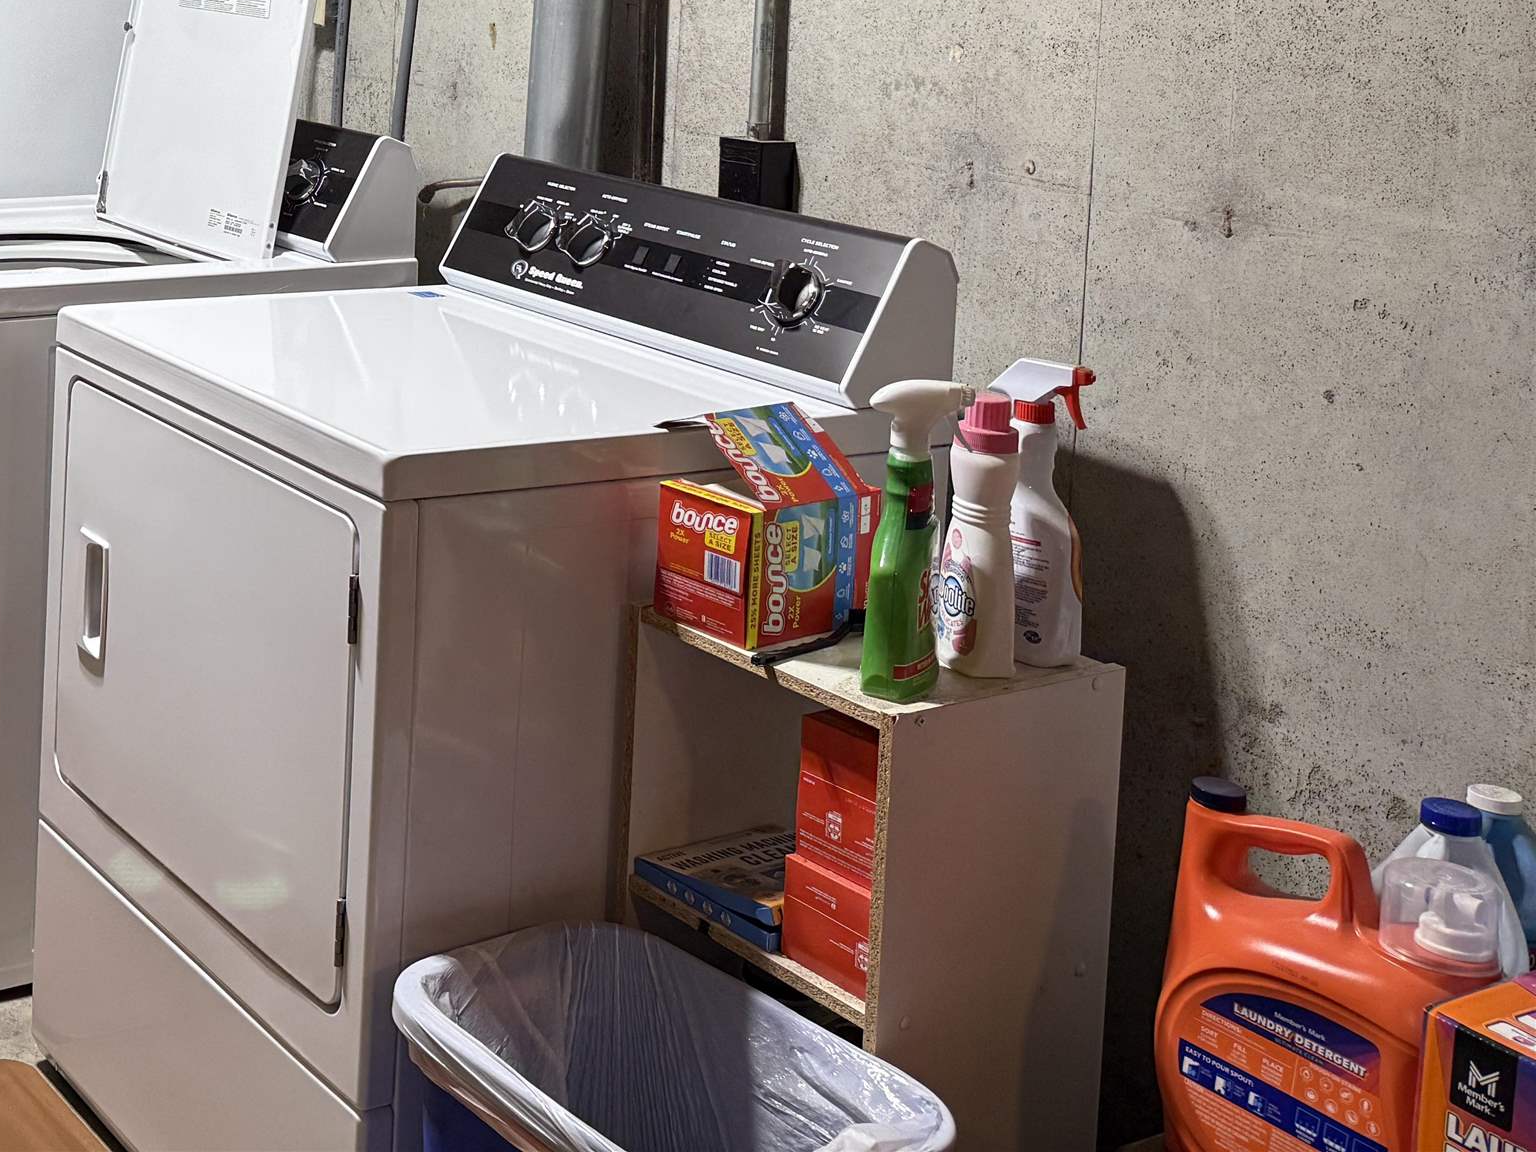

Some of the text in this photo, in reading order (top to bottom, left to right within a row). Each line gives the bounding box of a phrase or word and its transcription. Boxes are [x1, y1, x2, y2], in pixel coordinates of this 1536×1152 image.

[528, 265, 556, 281] Speed
[671, 500, 739, 534] bounce
[669, 531, 690, 545] Power
[675, 527, 685, 538] 2X
[708, 531, 733, 544] SELECT
[714, 540, 731, 552] SIZE
[791, 526, 799, 554] SIZE
[753, 532, 761, 572] SHEETS
[751, 573, 759, 606] MORE
[762, 521, 785, 636] bounce
[787, 605, 795, 622] 2X
[792, 595, 801, 629] Power
[939, 585, 976, 616] oolite
[670, 832, 796, 870] WASHING MACHIN
[1201, 1010, 1243, 1034] DIRECTIONS:
[1201, 1025, 1218, 1039] SORT
[1233, 1002, 1367, 1078] LAUNDRY DETERGENT
[1185, 1046, 1202, 1060] EASY
[1202, 1054, 1212, 1064] TO
[1211, 1060, 1230, 1075] POUR
[1261, 1058, 1284, 1073] PLACE
[1457, 1081, 1506, 1113] Member's
[1465, 1095, 1492, 1115] Mark
